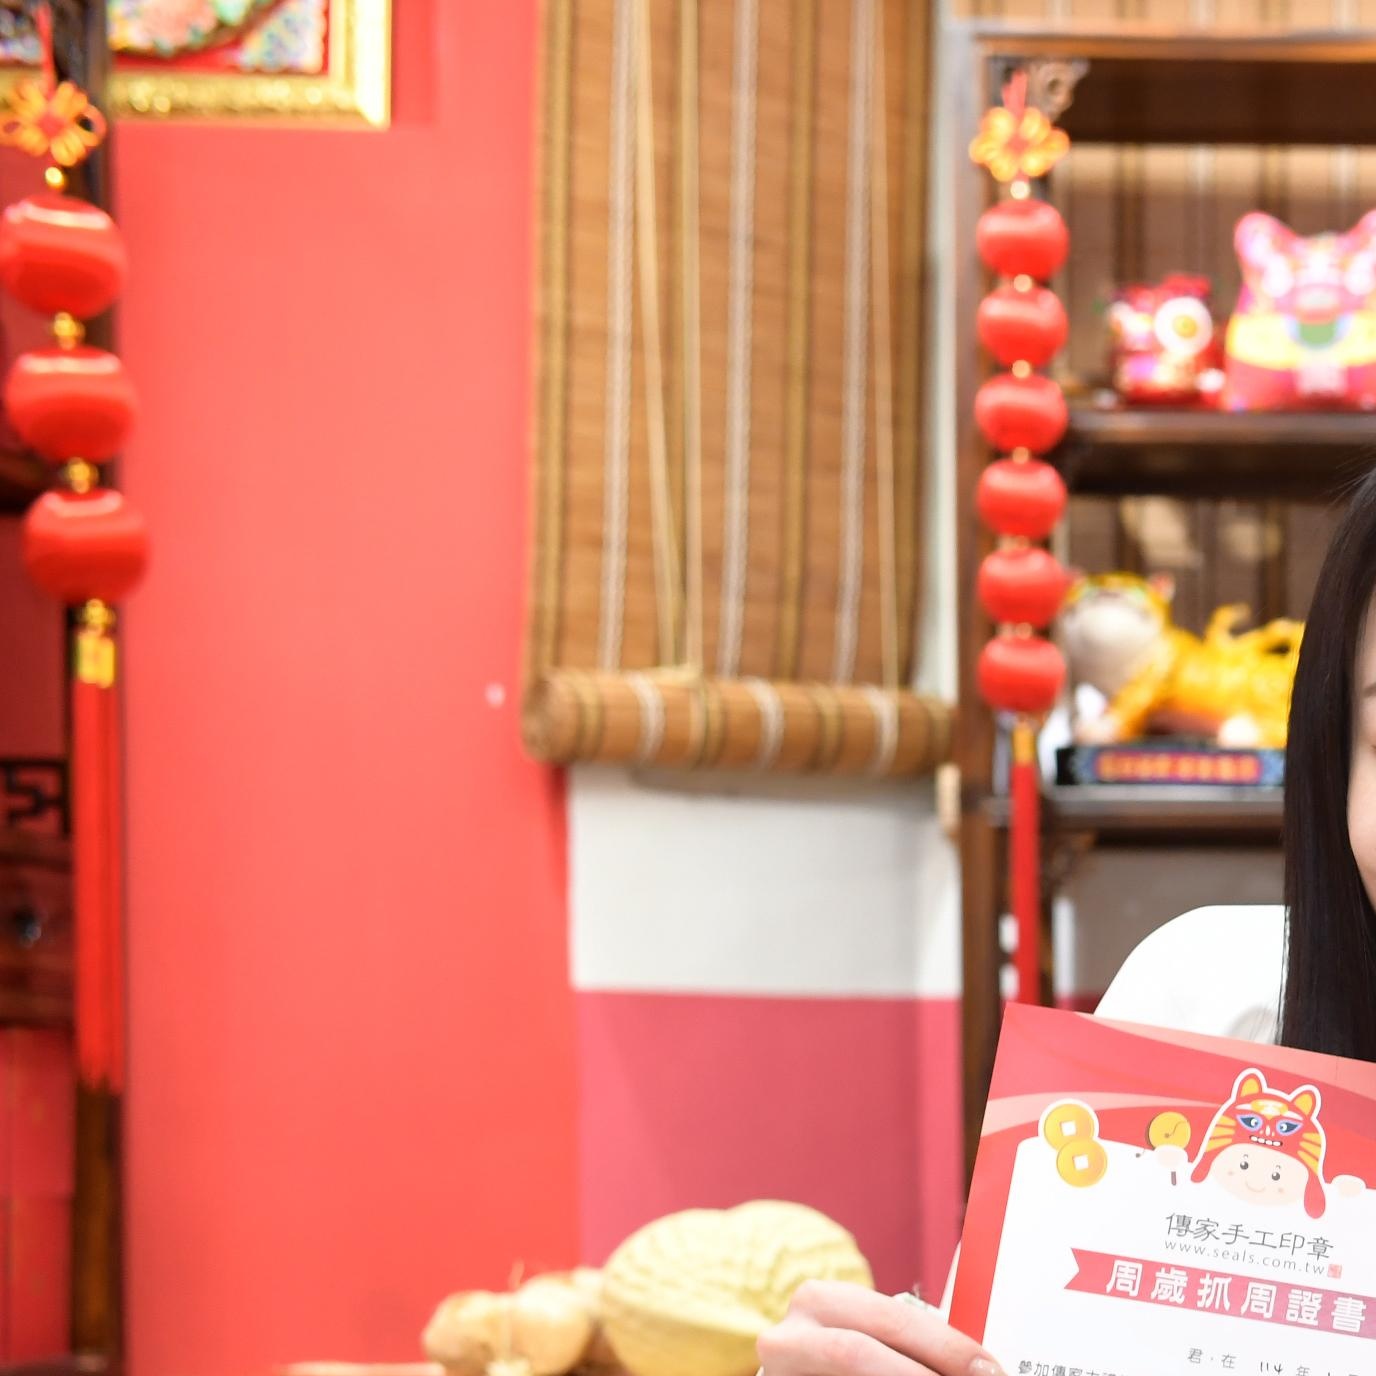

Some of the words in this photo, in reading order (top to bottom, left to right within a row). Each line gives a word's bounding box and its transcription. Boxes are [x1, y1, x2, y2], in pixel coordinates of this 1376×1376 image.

[1165, 1239, 1325, 1275] www.seals.com.tw
[1166, 1212, 1334, 1261] 傳家手工印章
[1106, 1259, 1366, 1333] 周歲抓周證書
[1260, 1361, 1283, 1375] 114
